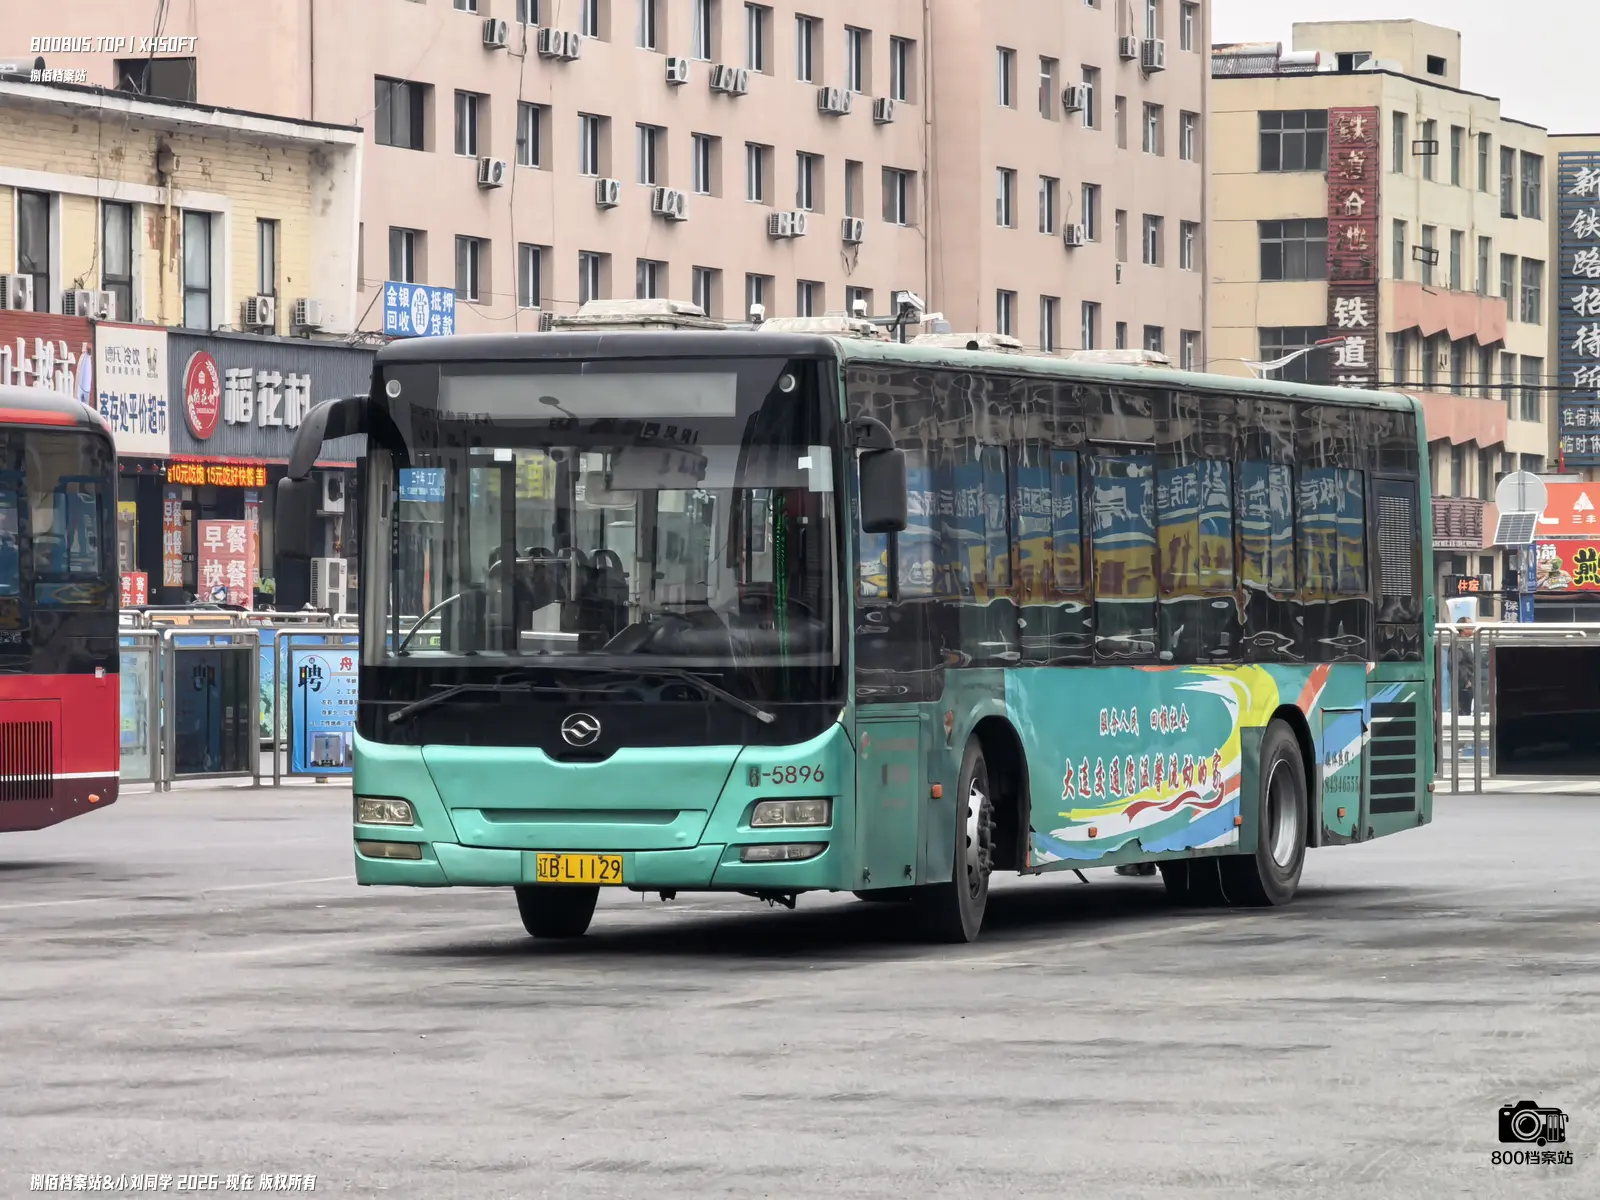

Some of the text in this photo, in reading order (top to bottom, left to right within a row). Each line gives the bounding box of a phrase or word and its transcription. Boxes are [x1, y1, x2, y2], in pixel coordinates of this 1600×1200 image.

[386, 285, 410, 308] 金银
[431, 290, 454, 313] 抵押
[386, 310, 410, 332] 回收
[431, 313, 453, 336] 贷款
[224, 368, 311, 429] 稻花村
[99, 391, 167, 435] 寄存处平价超市
[203, 525, 247, 553] 早餐
[203, 559, 247, 588] 快餐
[1573, 547, 1600, 587] 煎
[1457, 579, 1479, 594] 住宿
[298, 664, 324, 692] 聘
